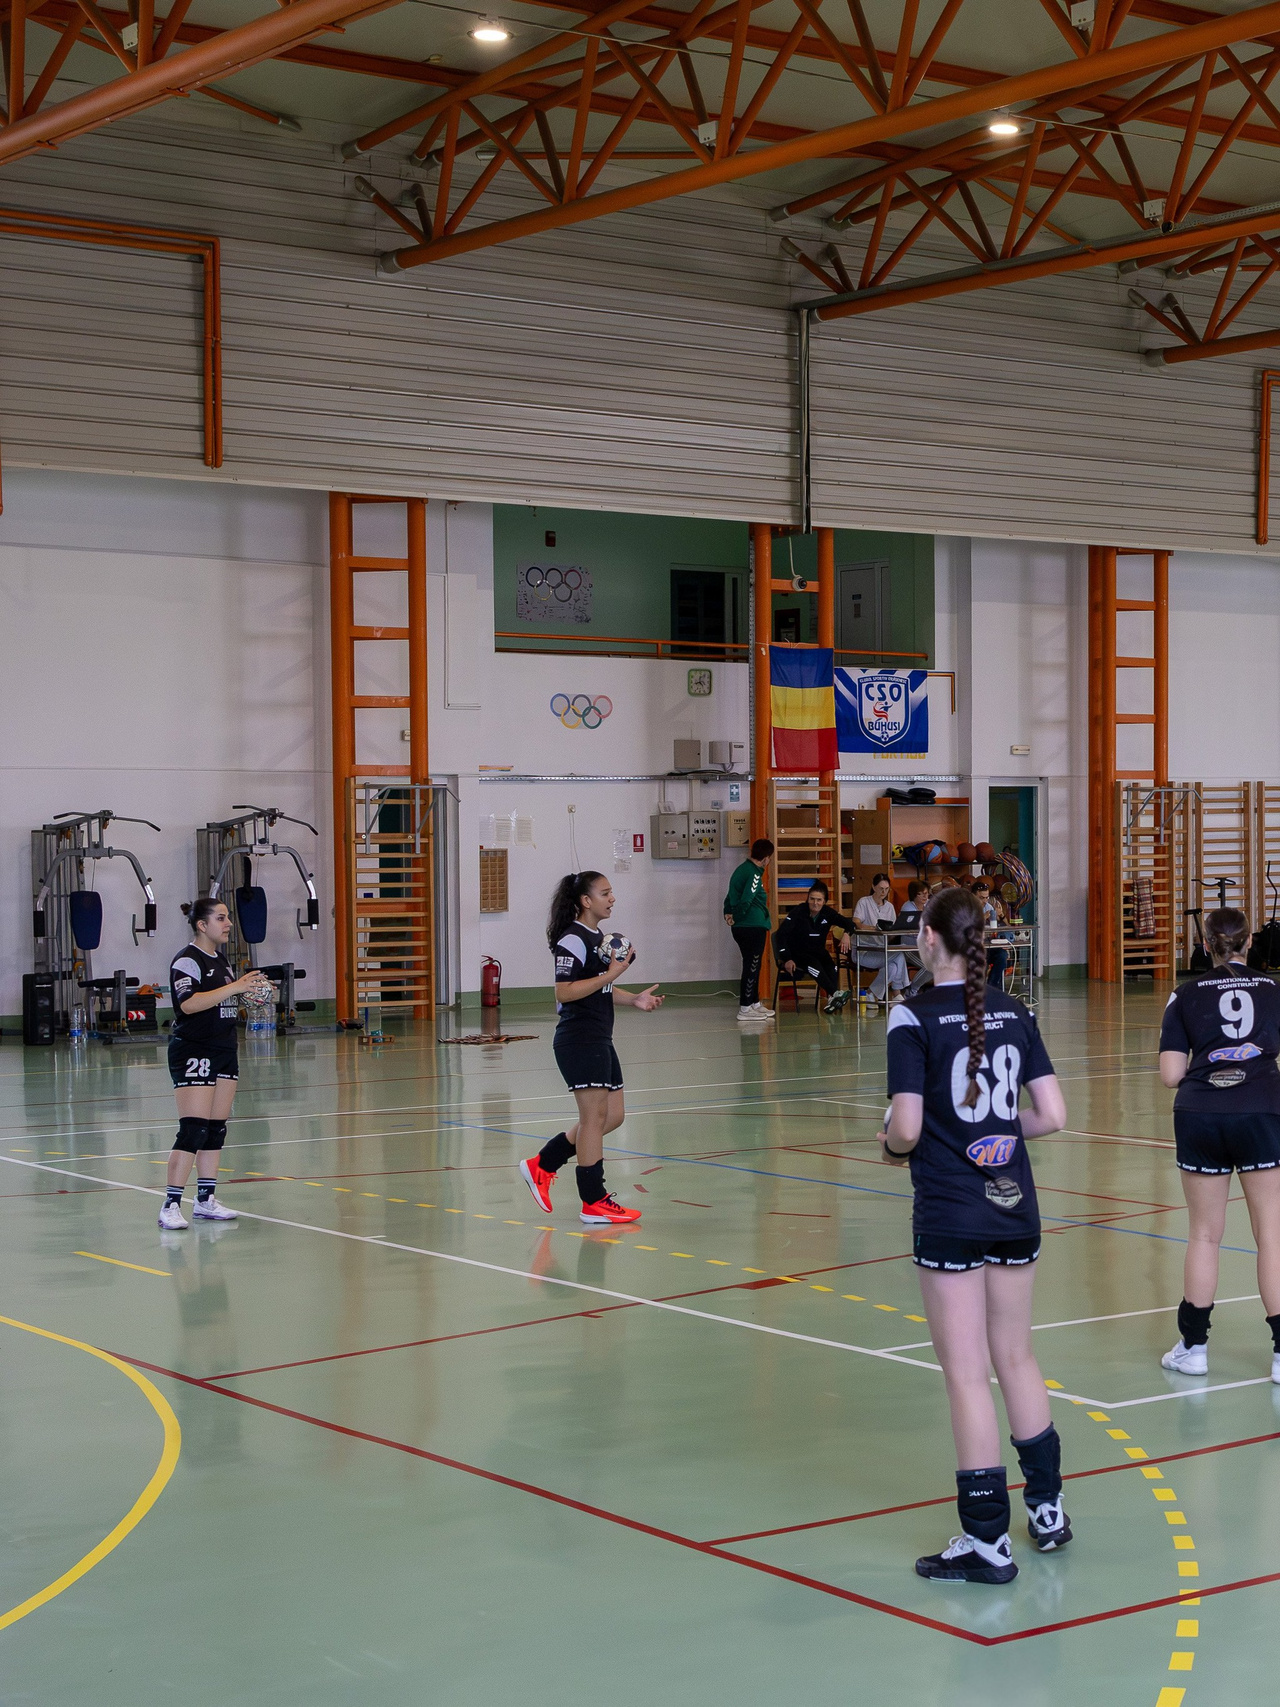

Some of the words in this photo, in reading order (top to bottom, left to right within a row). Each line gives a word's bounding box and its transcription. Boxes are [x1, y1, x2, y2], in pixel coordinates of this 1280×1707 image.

[865, 683, 902, 702] CSO
[1197, 977, 1251, 987] INTERNATIONAL
[1217, 981, 1259, 990] CONSTRUCT
[1218, 989, 1255, 1039] 9
[185, 1057, 211, 1078] 28
[950, 1043, 1021, 1124] 68
[1201, 1166, 1219, 1174] Kempa
[1257, 1161, 1276, 1169] Kempa
[944, 1261, 967, 1271] Kempa
[1006, 1257, 1030, 1265] Kempa
